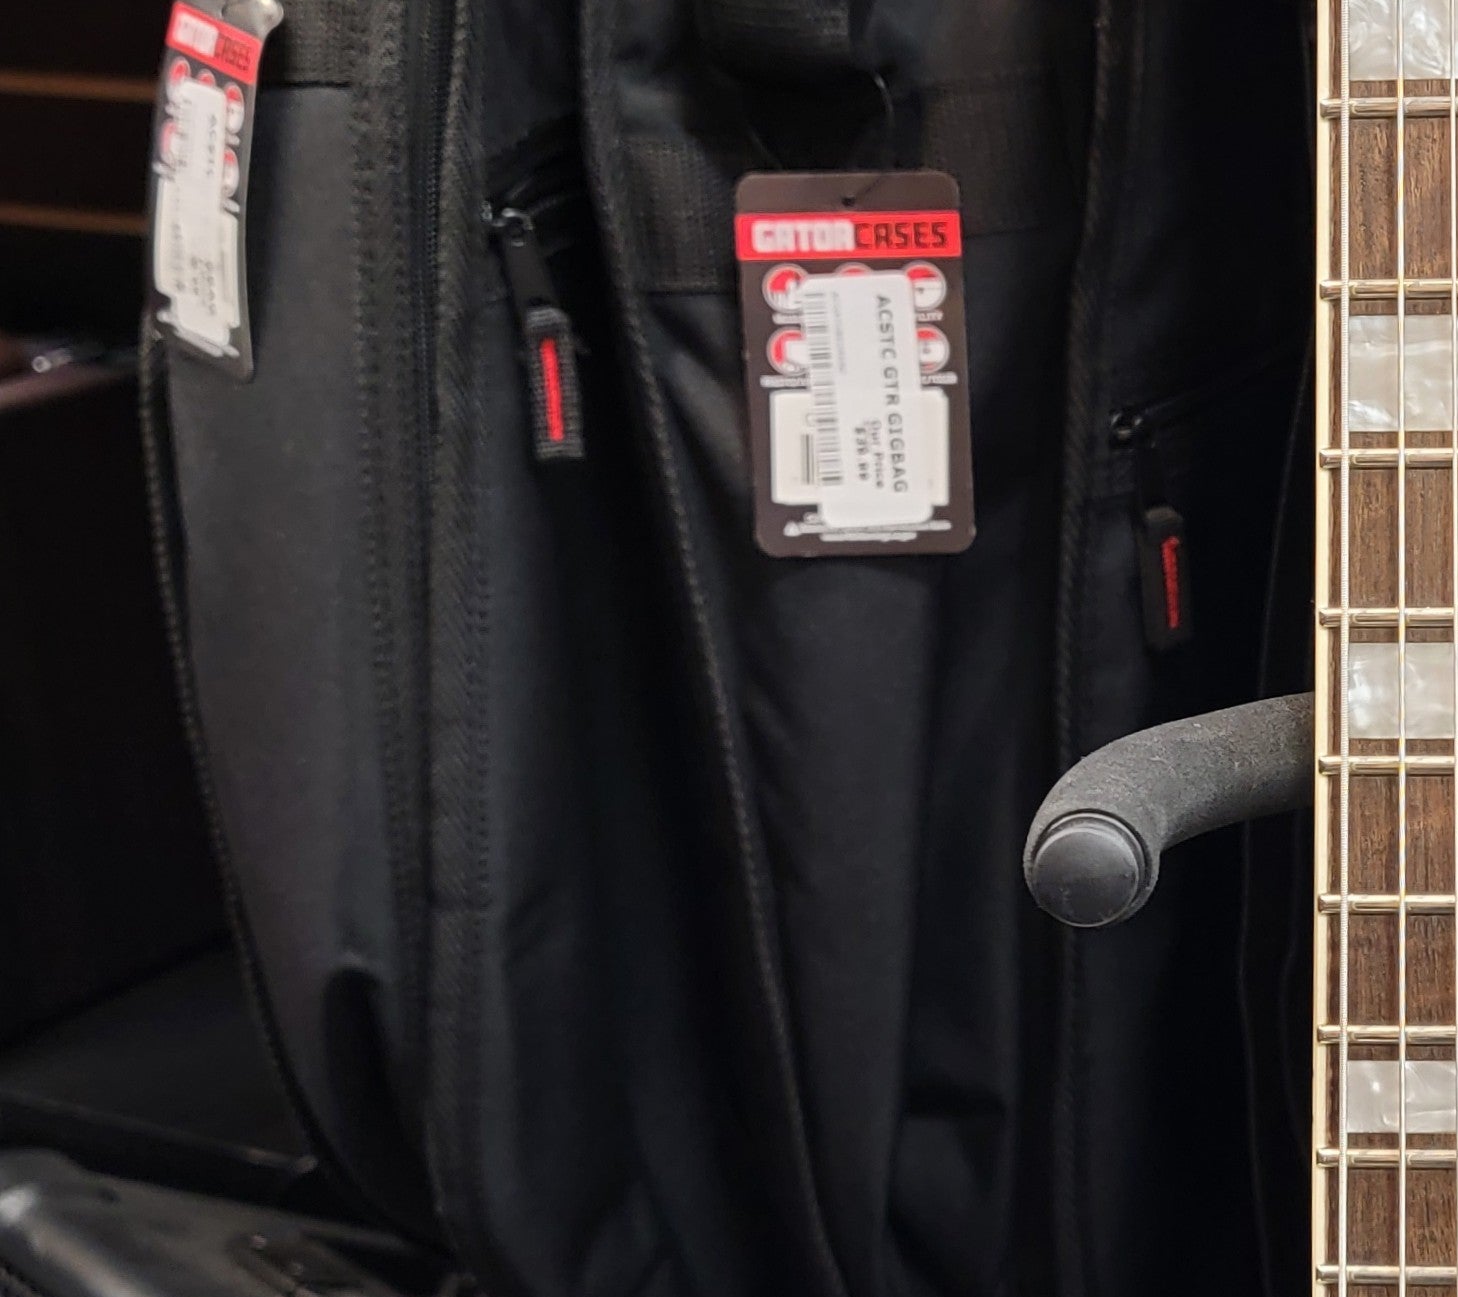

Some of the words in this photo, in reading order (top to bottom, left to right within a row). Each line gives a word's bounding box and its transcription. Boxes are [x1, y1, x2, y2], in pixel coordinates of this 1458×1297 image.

[876, 294, 898, 361] ACSTC
[883, 367, 901, 405] GTR
[873, 452, 886, 489] Price
[888, 413, 909, 493] GIGBAG
